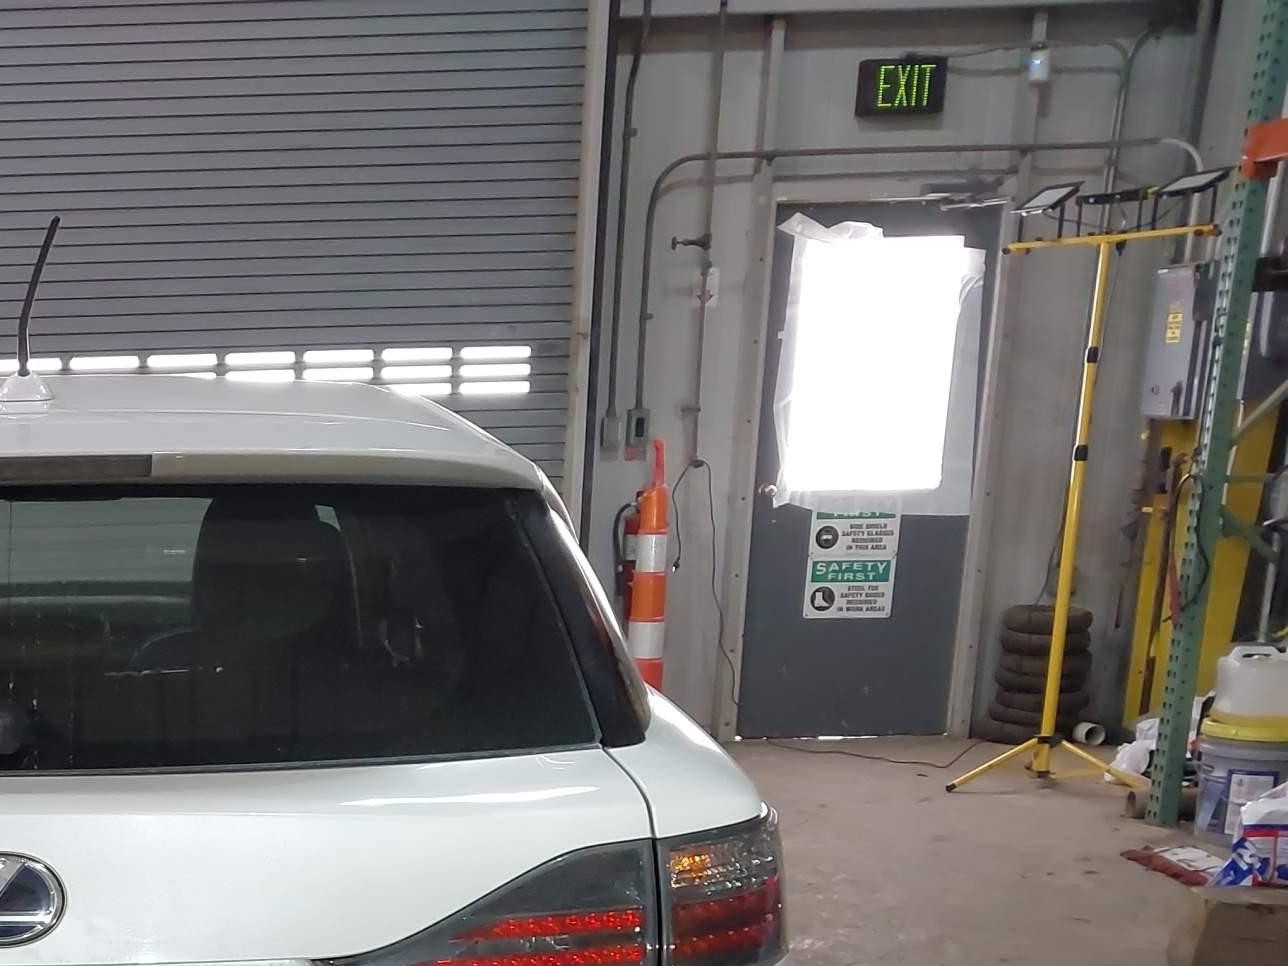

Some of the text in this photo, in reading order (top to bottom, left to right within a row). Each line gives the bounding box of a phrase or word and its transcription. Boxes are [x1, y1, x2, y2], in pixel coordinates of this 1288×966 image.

[877, 64, 937, 106] EXIT
[815, 562, 888, 575] SAFETY
[827, 572, 877, 581] FIRST
